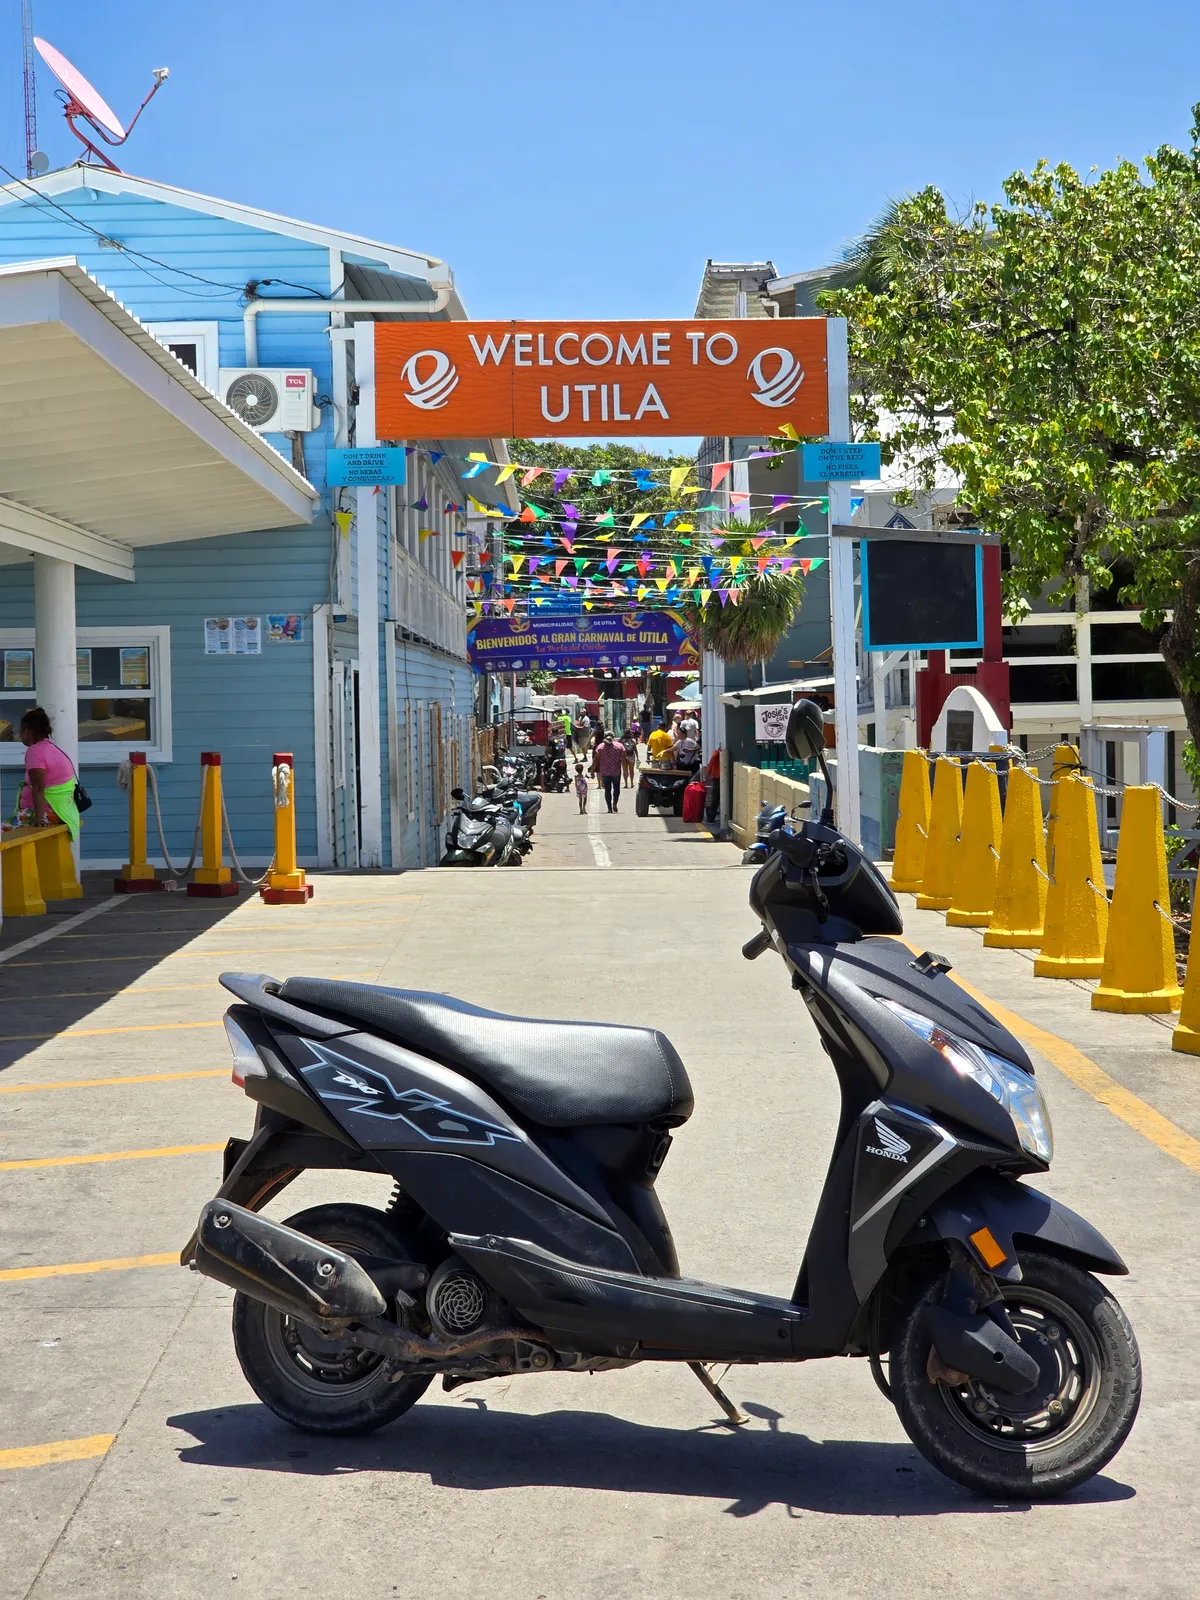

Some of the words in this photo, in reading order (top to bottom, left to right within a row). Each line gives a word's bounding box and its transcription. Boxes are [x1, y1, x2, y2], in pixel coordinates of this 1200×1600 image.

[468, 332, 671, 367] WELCOME
[685, 331, 738, 366] TO
[541, 382, 669, 423] UTILA
[476, 633, 538, 650] BIENVENIDOS
[541, 634, 550, 644] AL
[551, 632, 577, 643] GRAN
[578, 631, 625, 643] CARNAVAL
[627, 633, 637, 642] DE
[639, 631, 669, 644] UTILA
[535, 645, 546, 653] La
[547, 644, 568, 652] Perla
[569, 643, 580, 651] del
[582, 643, 607, 651] Caribe
[761, 706, 788, 723] Josie's
[865, 1145, 908, 1164] HONDA
